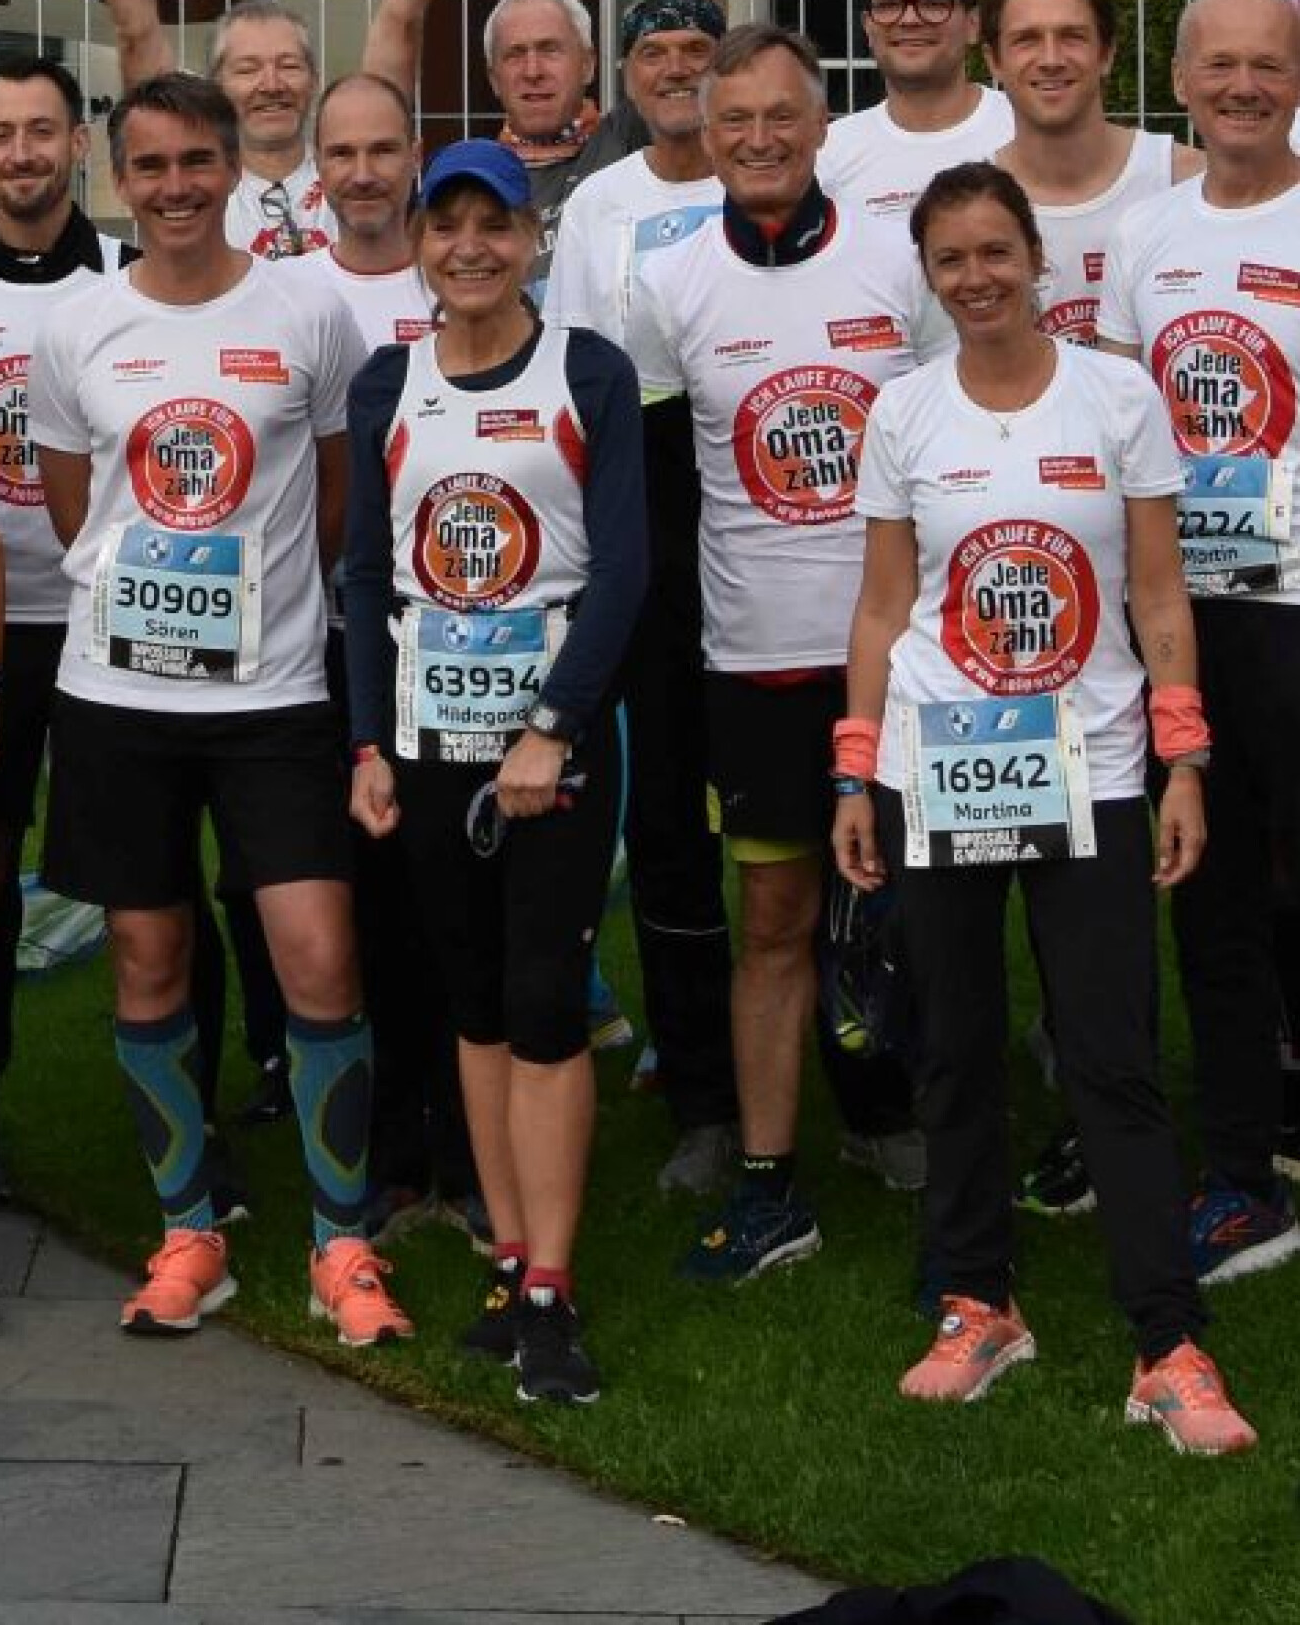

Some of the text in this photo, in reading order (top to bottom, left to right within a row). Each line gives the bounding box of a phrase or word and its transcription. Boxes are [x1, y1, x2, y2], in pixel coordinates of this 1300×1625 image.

[1187, 349, 1240, 375] Jede
[773, 370, 826, 394] LAUFE
[1176, 370, 1241, 407] Oma
[5, 387, 29, 409] Je
[782, 401, 840, 429] Jede
[170, 428, 214, 446] Jede
[766, 426, 845, 460] Oma
[157, 444, 214, 471] Oma
[164, 472, 217, 496] zählt
[783, 453, 858, 490] zählt
[450, 502, 496, 523] Jede
[439, 519, 496, 551] Oma
[959, 538, 985, 567] ICH
[983, 524, 1039, 548] LAUFE
[444, 552, 501, 579] zählt
[991, 561, 1049, 587] Jede
[115, 576, 232, 619] 30909
[976, 585, 1050, 621] Oma
[144, 618, 199, 640] Sören
[989, 620, 1057, 655] zählt
[425, 664, 540, 699] 63934
[436, 703, 529, 726] Hildegard
[930, 752, 1051, 794] 16942
[953, 800, 1033, 820] Martina
